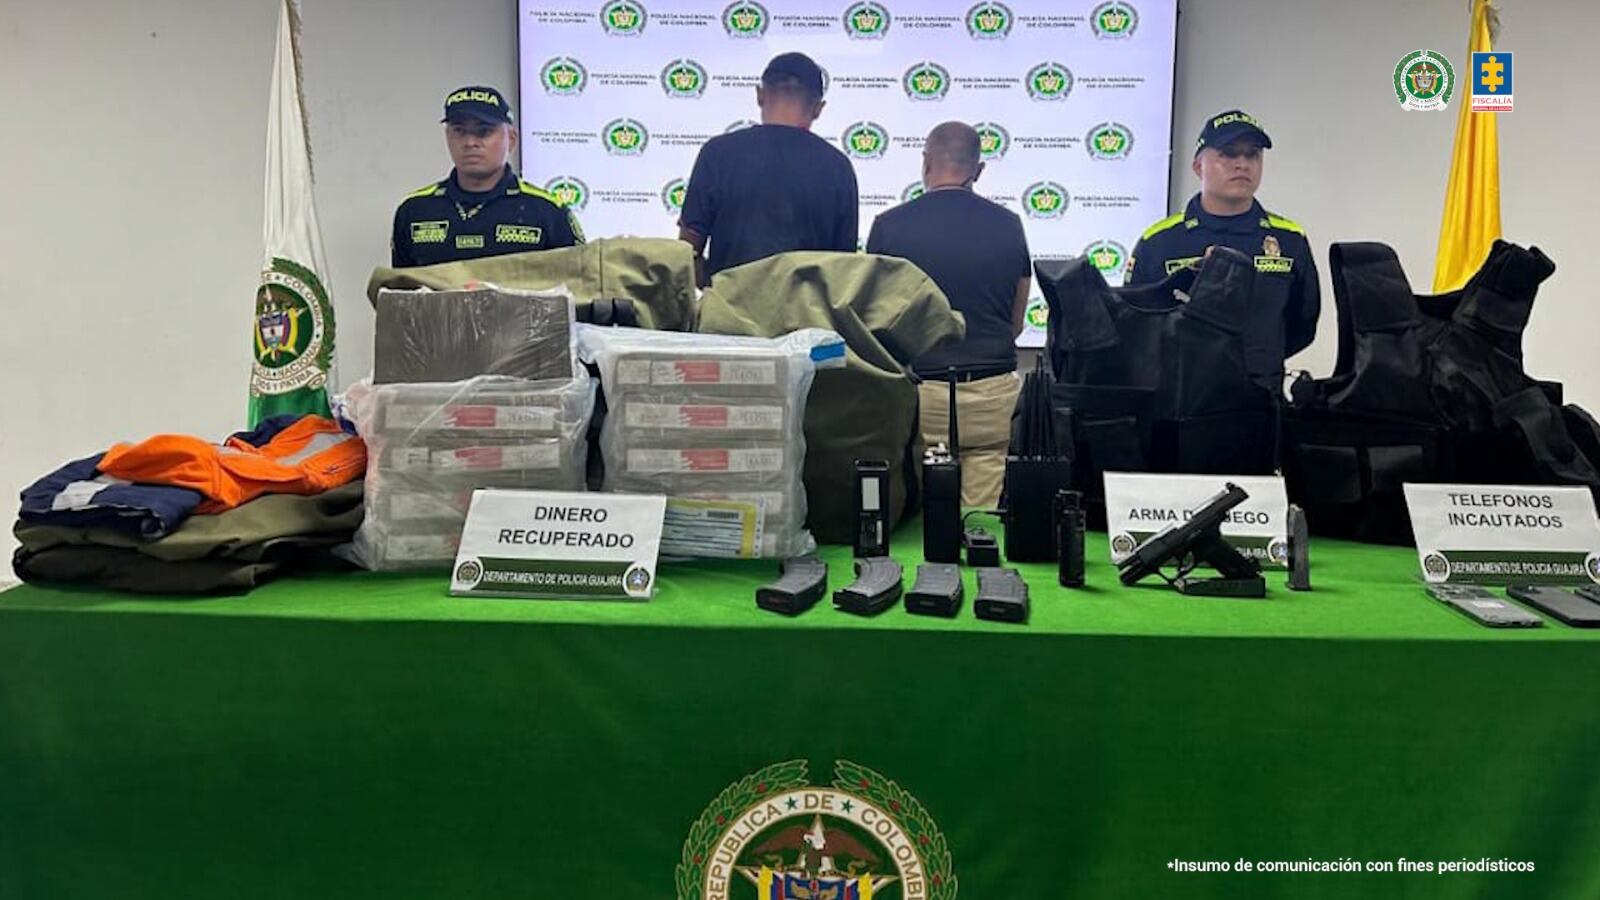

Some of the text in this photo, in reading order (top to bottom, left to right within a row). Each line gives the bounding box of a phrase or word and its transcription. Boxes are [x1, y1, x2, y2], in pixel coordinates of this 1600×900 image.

[448, 89, 500, 106] POLICIA
[1448, 493, 1553, 508] TELEFONOS
[534, 506, 608, 523] DINERO
[1128, 508, 1178, 522] ARMA
[1223, 510, 1270, 524] EGO
[1448, 513, 1563, 528] INCAUTADOS
[498, 528, 634, 548] RECUPERADO
[1450, 562, 1510, 574] DEPARTAMENTO
[1511, 562, 1522, 575] DE
[483, 570, 544, 584] DEPARTAMENTO
[545, 573, 556, 584] DE
[557, 573, 588, 586] POLICIA
[708, 793, 922, 900] REPUBLICA DE COLOMBI
